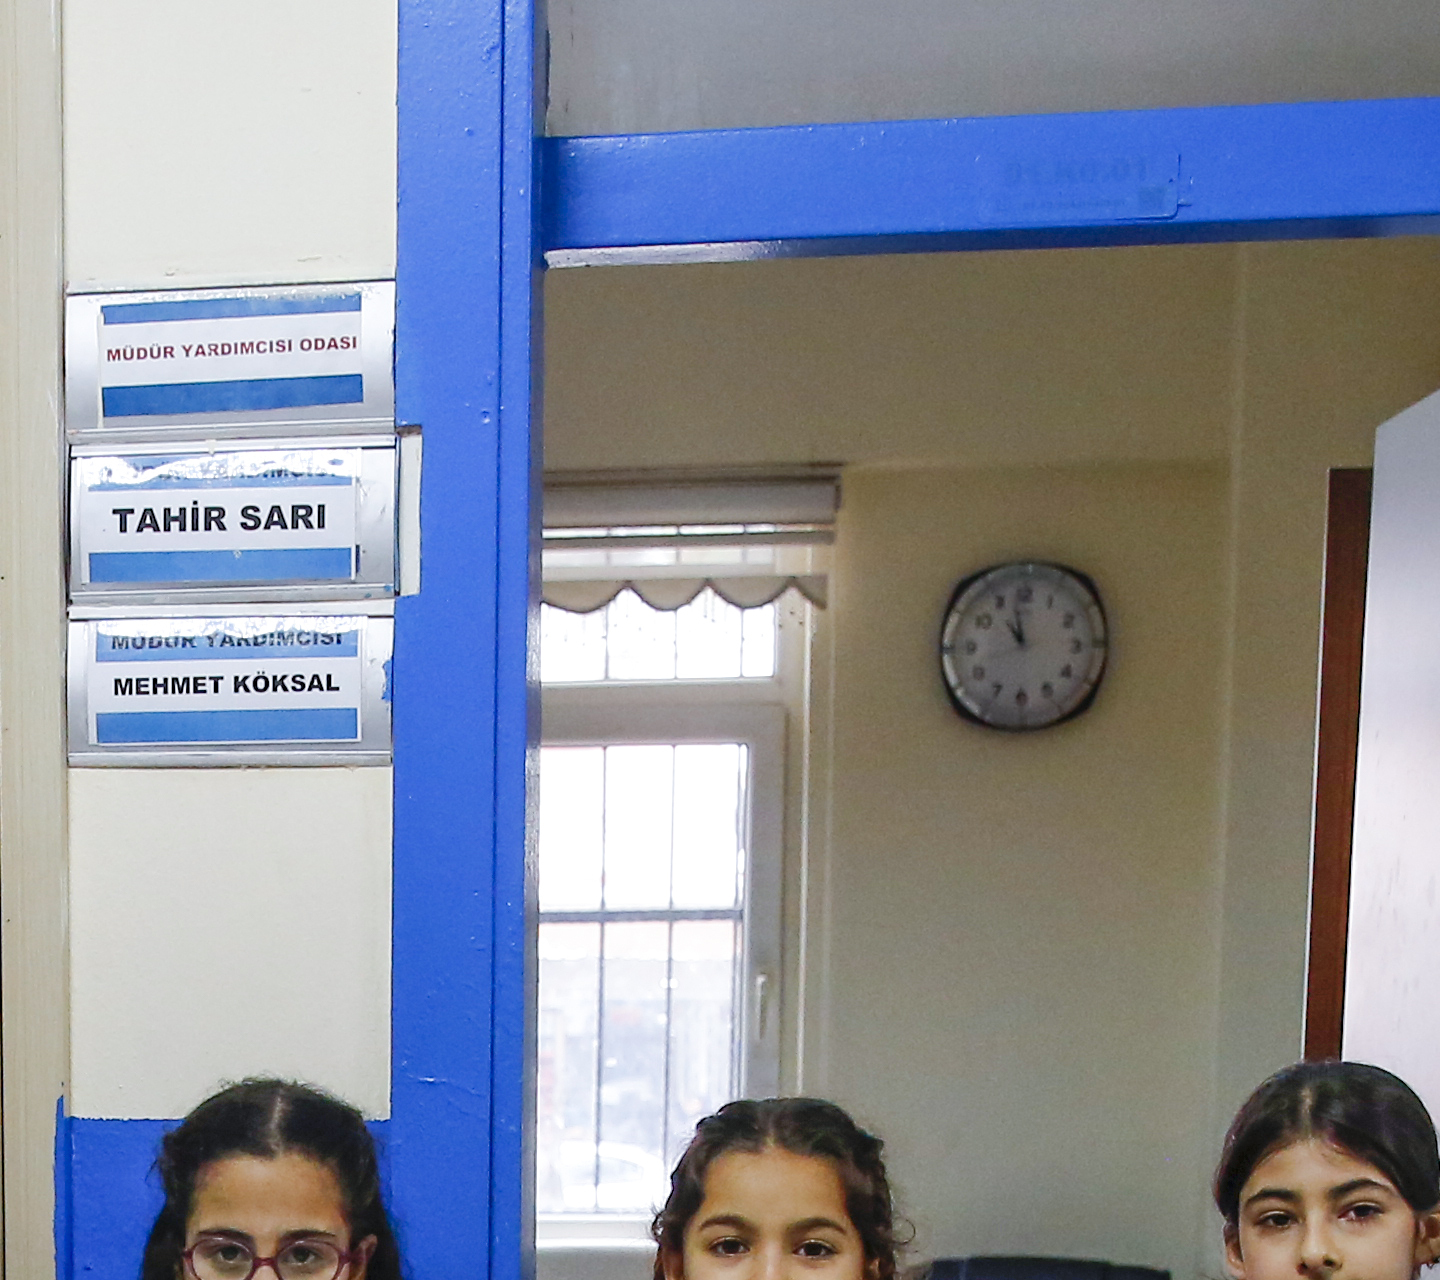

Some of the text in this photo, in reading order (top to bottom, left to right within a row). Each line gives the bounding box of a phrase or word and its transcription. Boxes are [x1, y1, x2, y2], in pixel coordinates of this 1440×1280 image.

[106, 335, 357, 362] MÜDÜR YARDIMCISI ODASI
[112, 500, 326, 533] TAHİR SARI
[113, 670, 340, 696] MEHMET KÖKSAL
